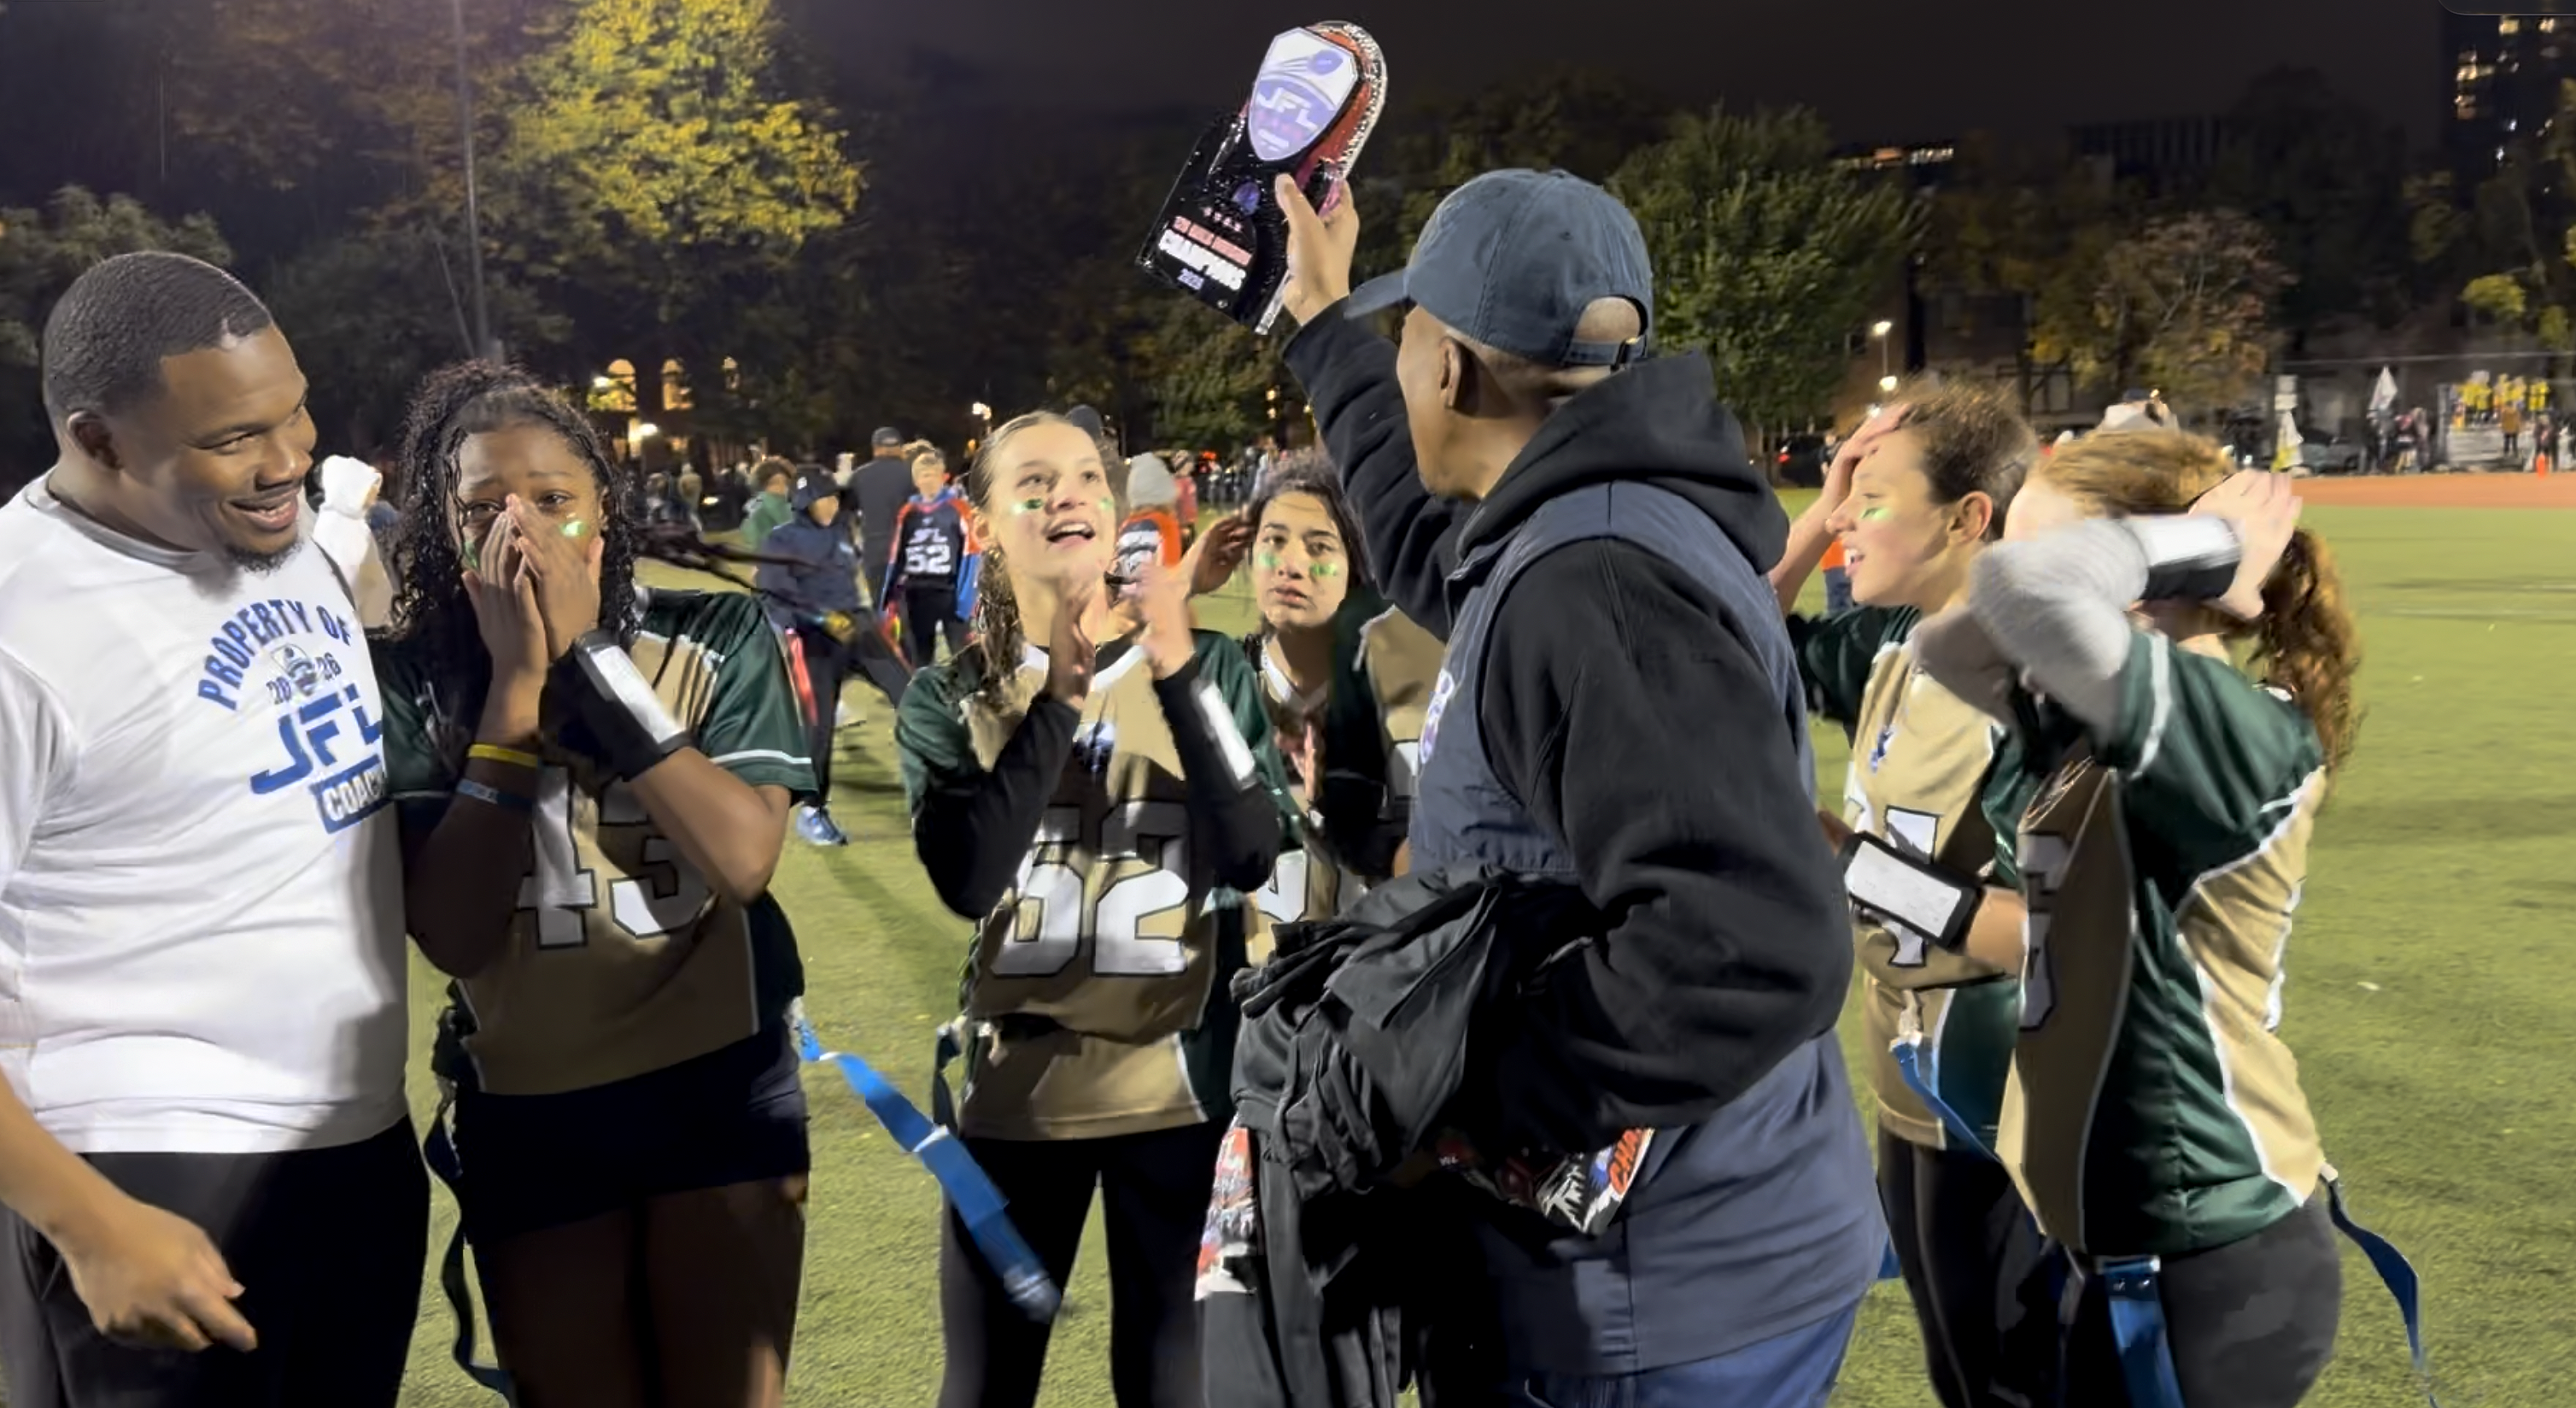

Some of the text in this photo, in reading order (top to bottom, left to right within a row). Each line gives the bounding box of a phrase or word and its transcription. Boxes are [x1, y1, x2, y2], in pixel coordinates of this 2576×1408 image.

[1256, 86, 1319, 129] JFL
[905, 543, 952, 574] 52
[197, 598, 313, 711] PROPERTY
[249, 683, 384, 795] JFL
